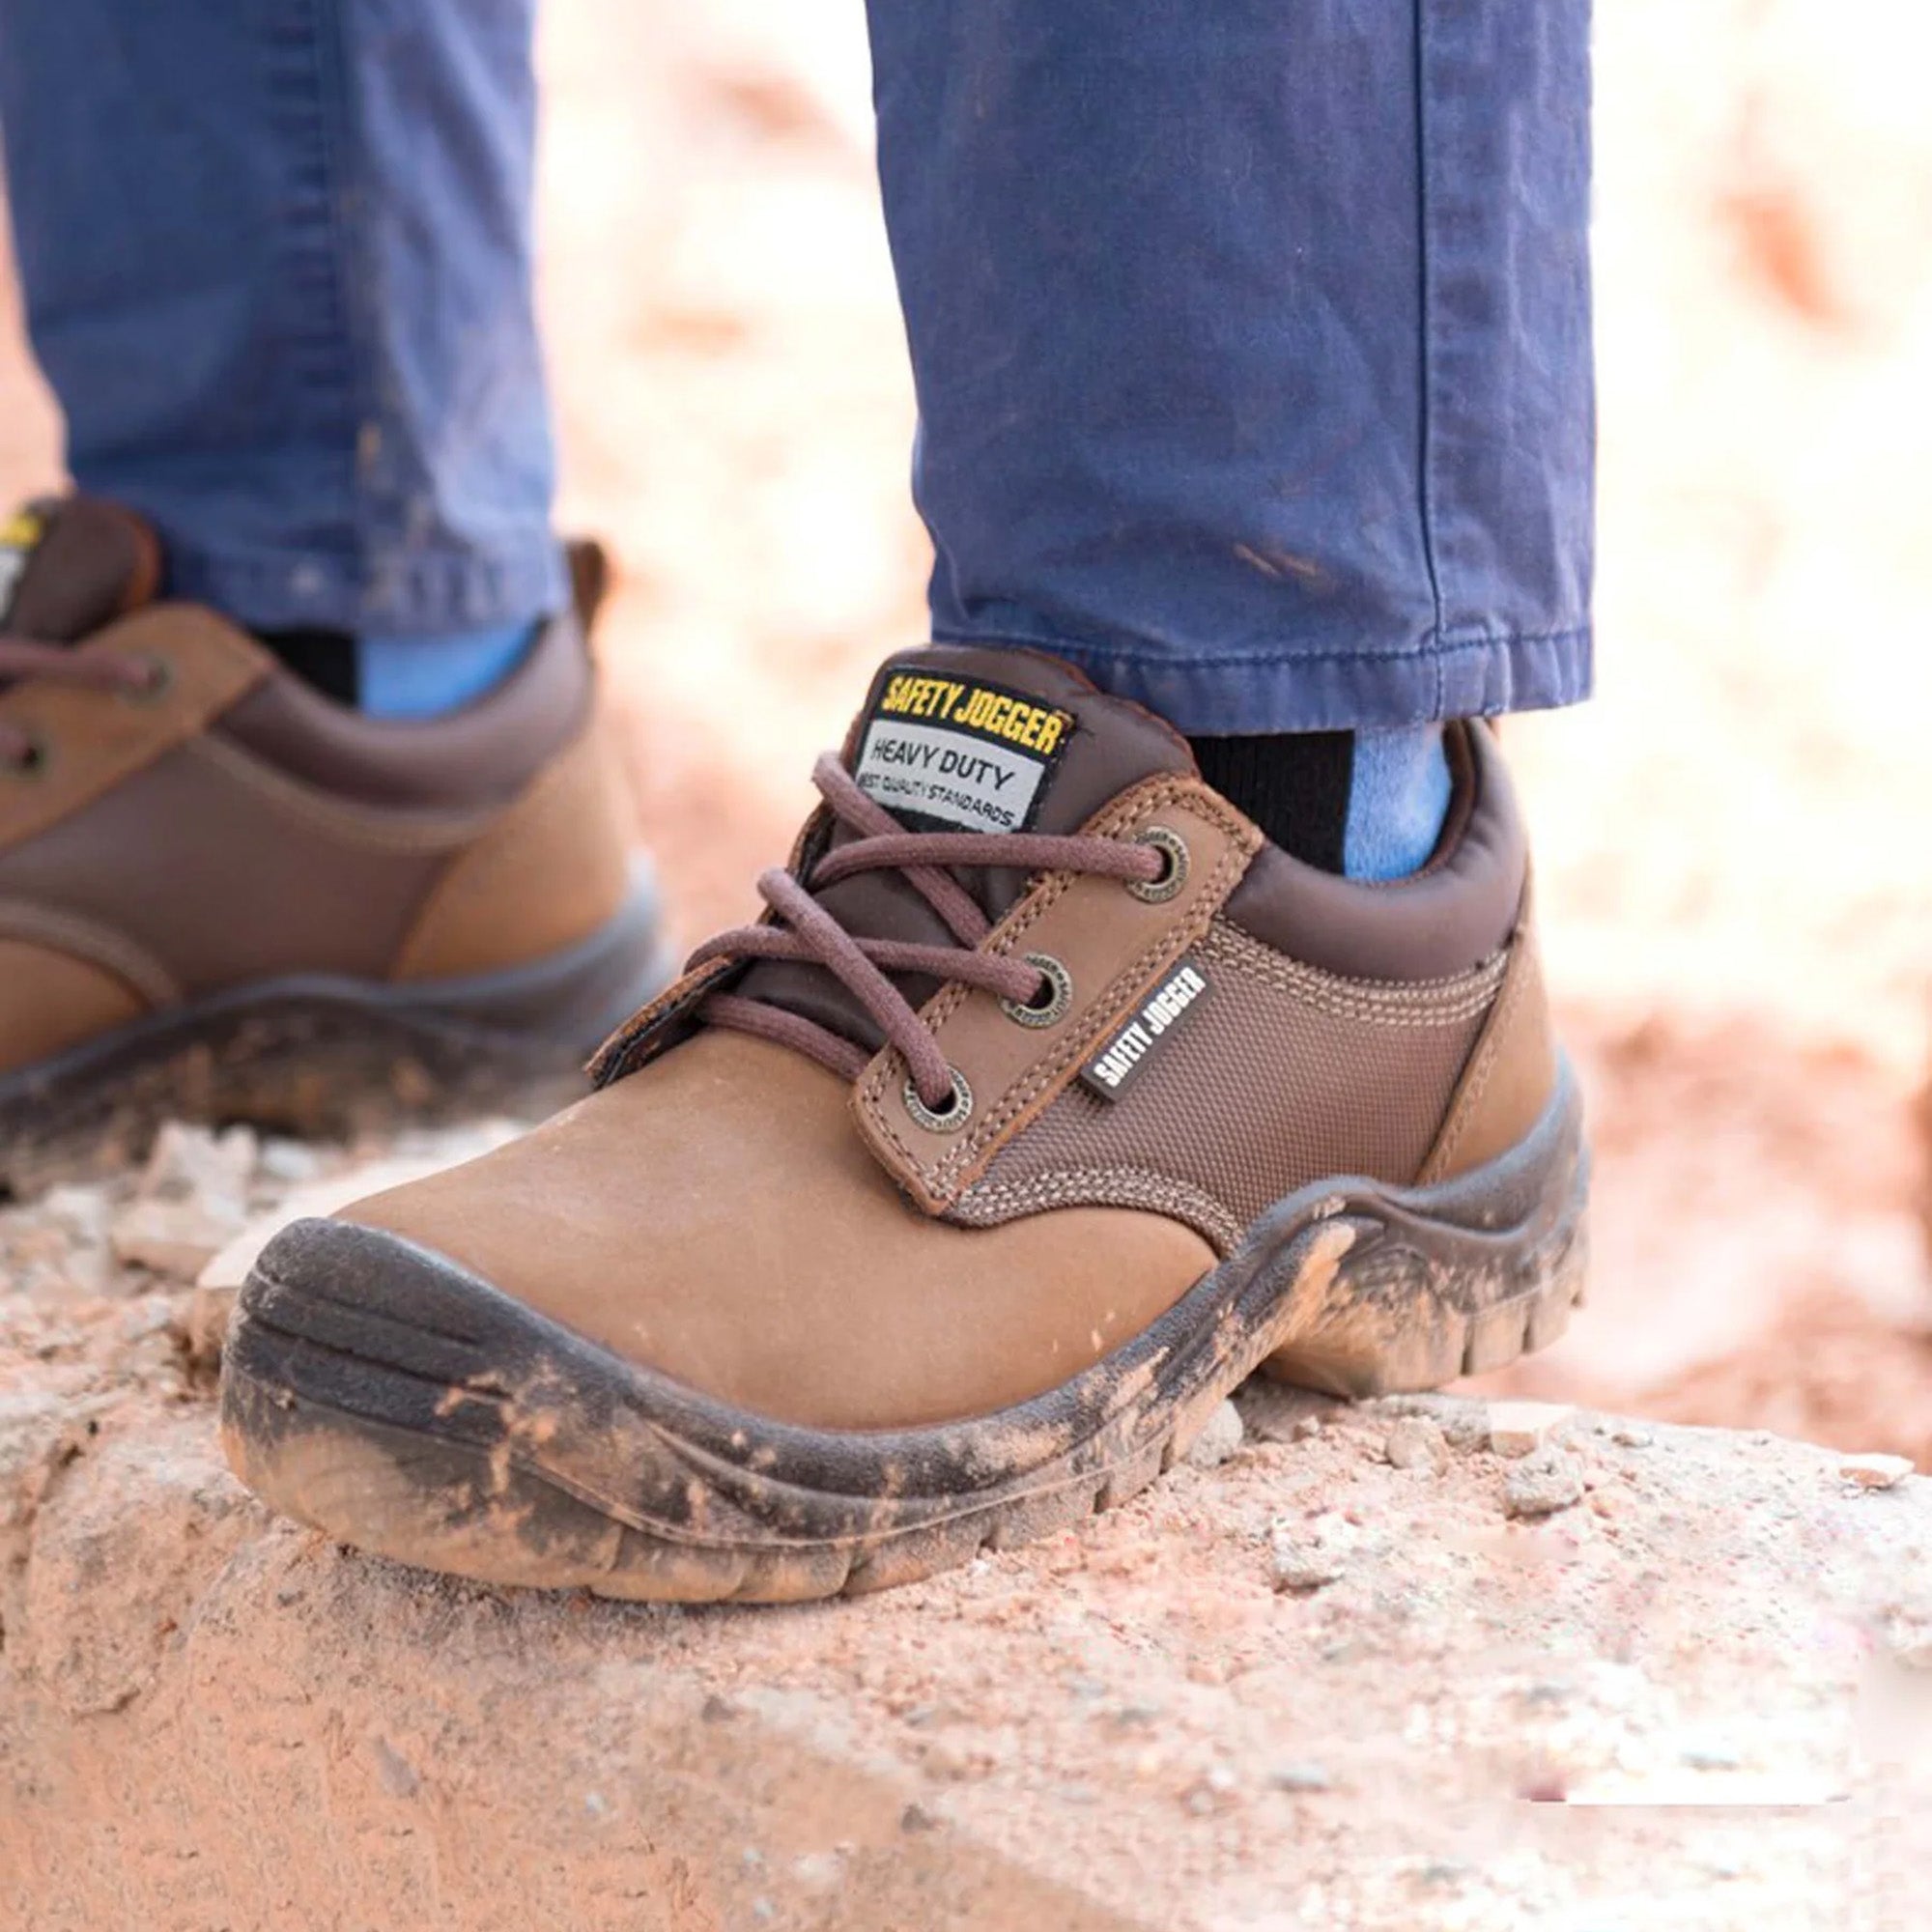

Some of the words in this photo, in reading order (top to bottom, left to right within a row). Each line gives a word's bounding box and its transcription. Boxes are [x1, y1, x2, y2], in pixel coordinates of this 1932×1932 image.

[882, 676, 965, 719] SAFETY
[953, 688, 1065, 755] JOGGER
[871, 738, 940, 768] HEAVY
[939, 750, 1015, 790] DUTY
[927, 783, 1015, 827] STANDARDS
[1094, 1021, 1153, 1087] SAFETY
[1142, 966, 1207, 1036] JOGGER
